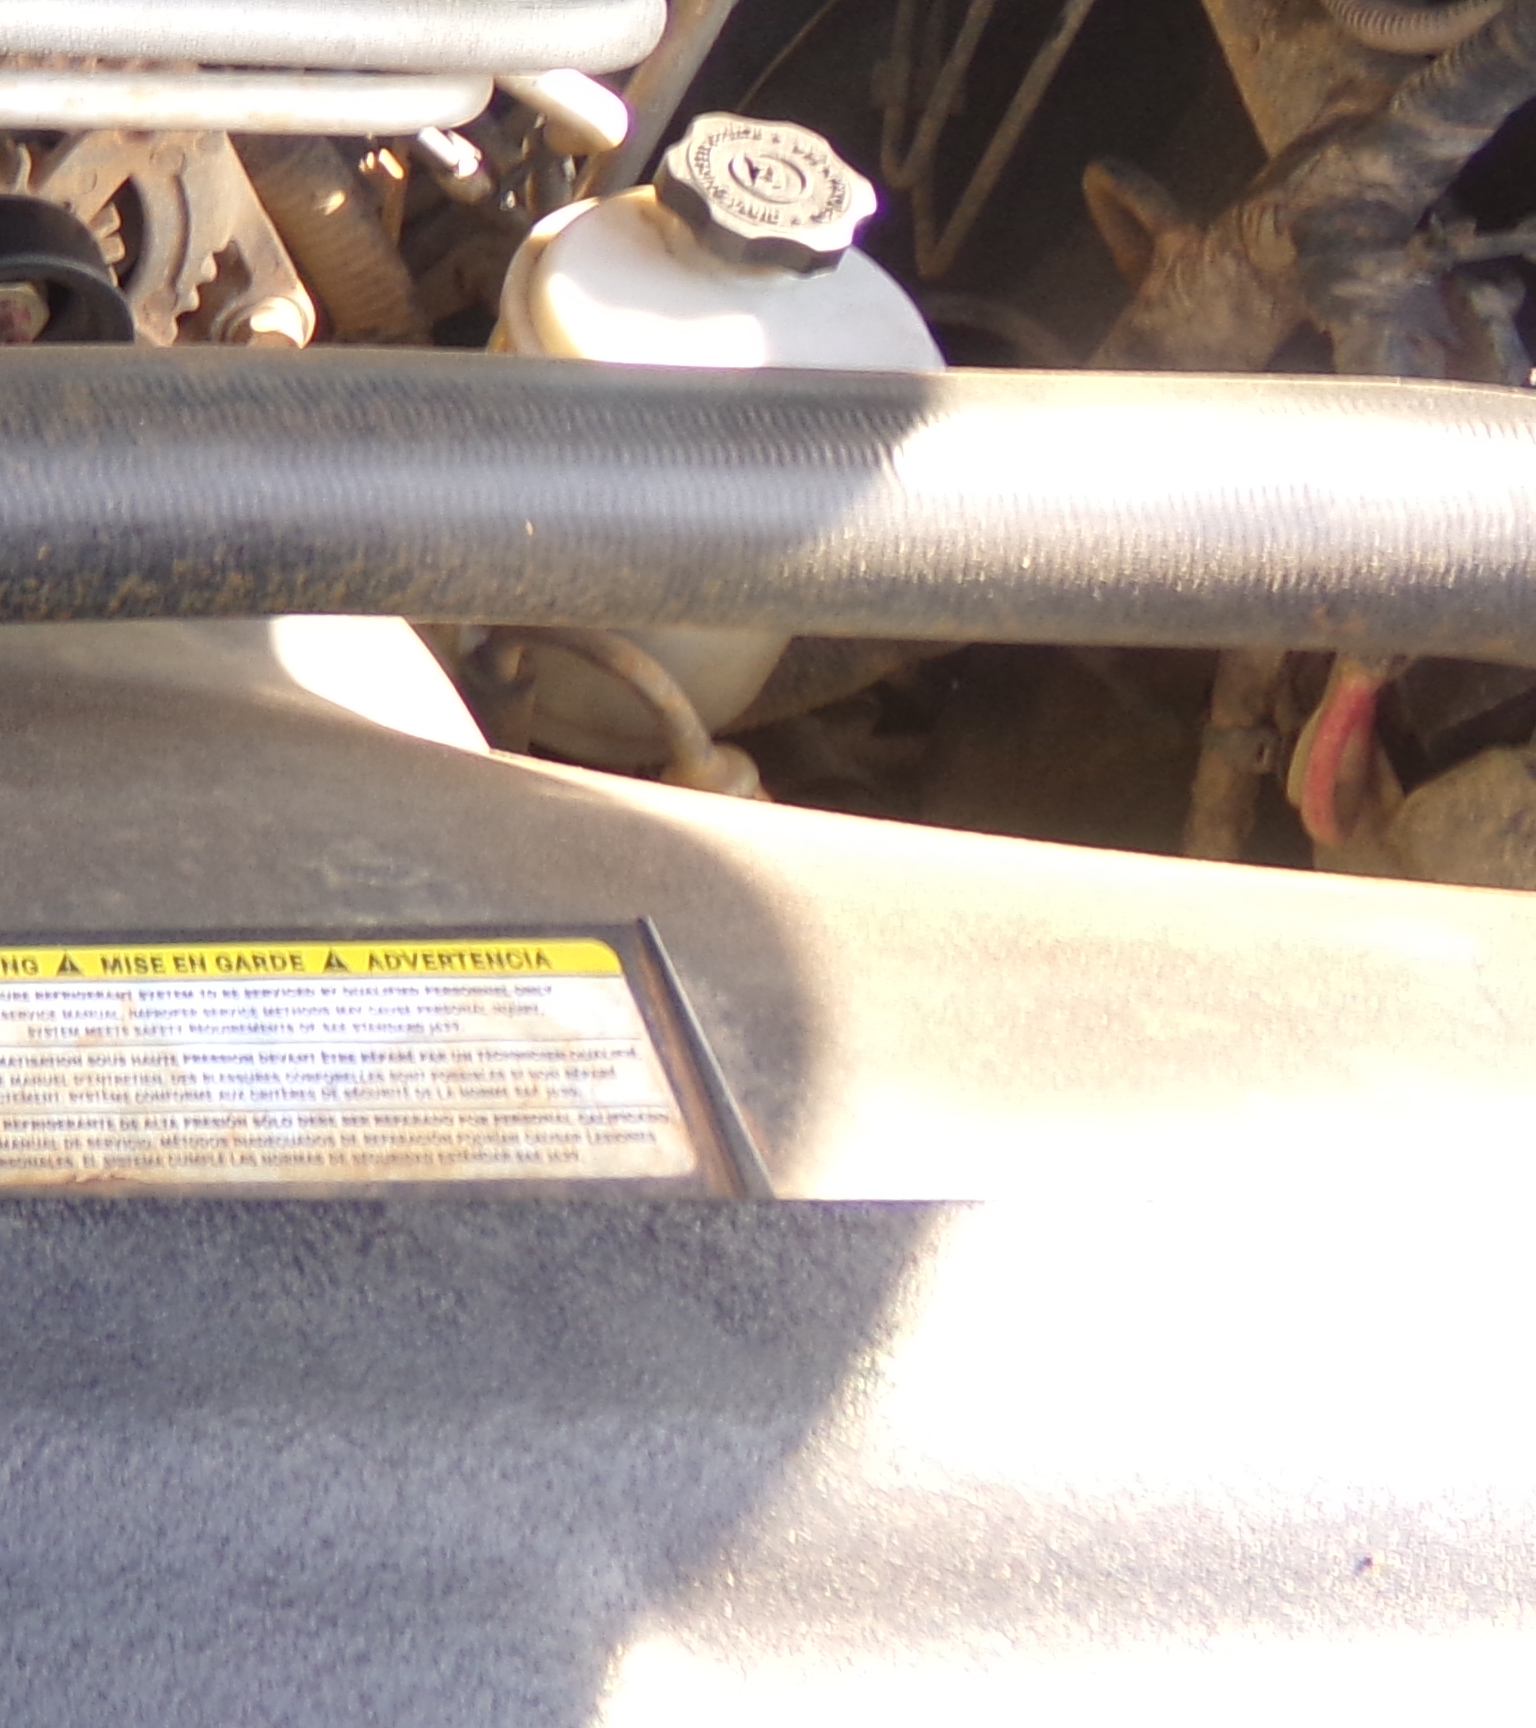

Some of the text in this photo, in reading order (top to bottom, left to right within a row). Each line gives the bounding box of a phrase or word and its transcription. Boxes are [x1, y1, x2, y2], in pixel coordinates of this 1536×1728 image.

[100, 952, 304, 975] MISE EN GARDE
[367, 948, 554, 972] ADVERTENCIA
